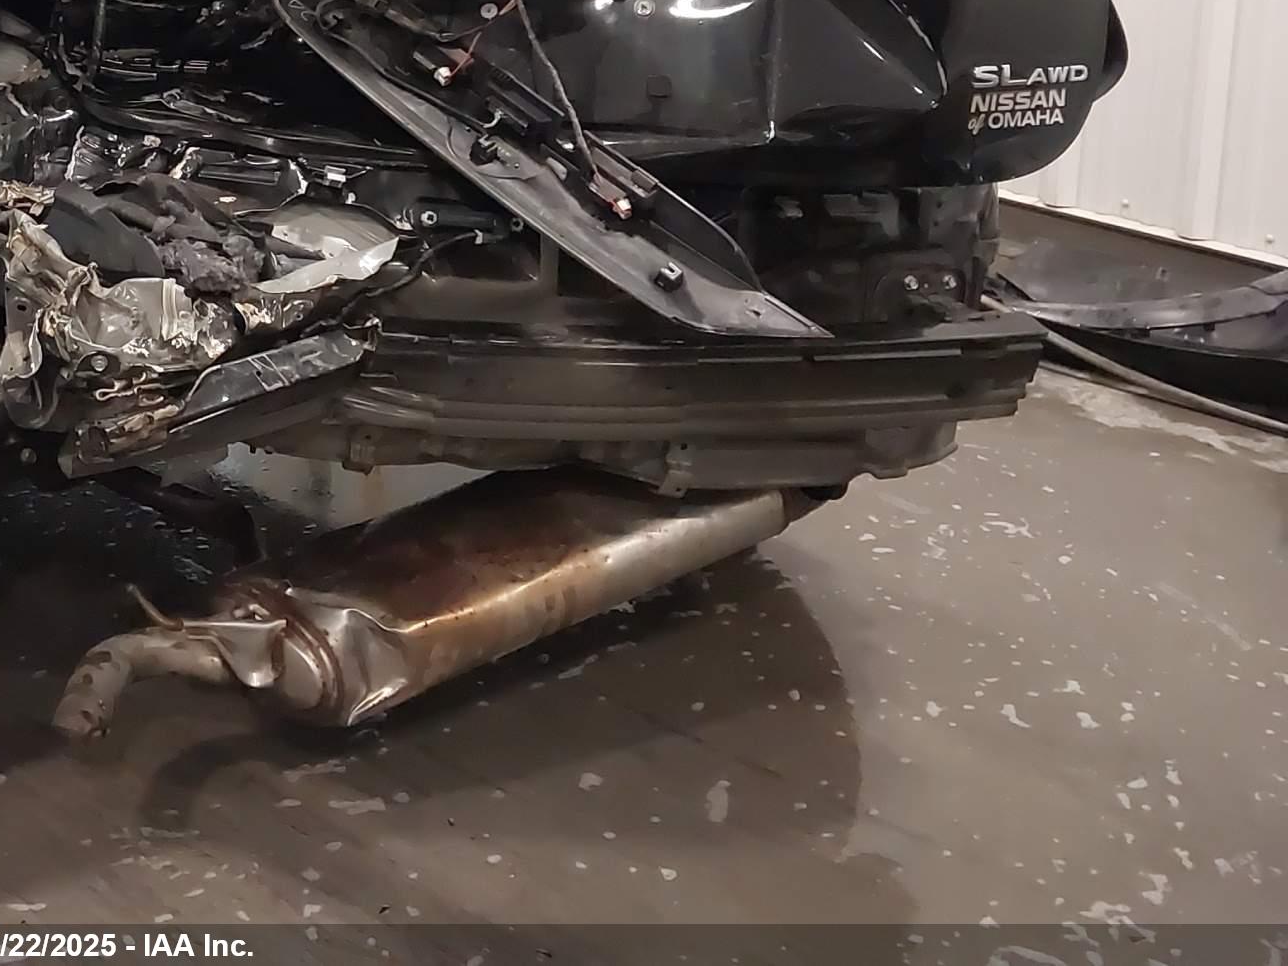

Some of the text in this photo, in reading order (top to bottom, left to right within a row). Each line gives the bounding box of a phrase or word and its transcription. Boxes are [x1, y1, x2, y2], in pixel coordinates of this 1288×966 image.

[970, 87, 1067, 113] NISSAN
[968, 108, 1065, 136] of OMAHA
